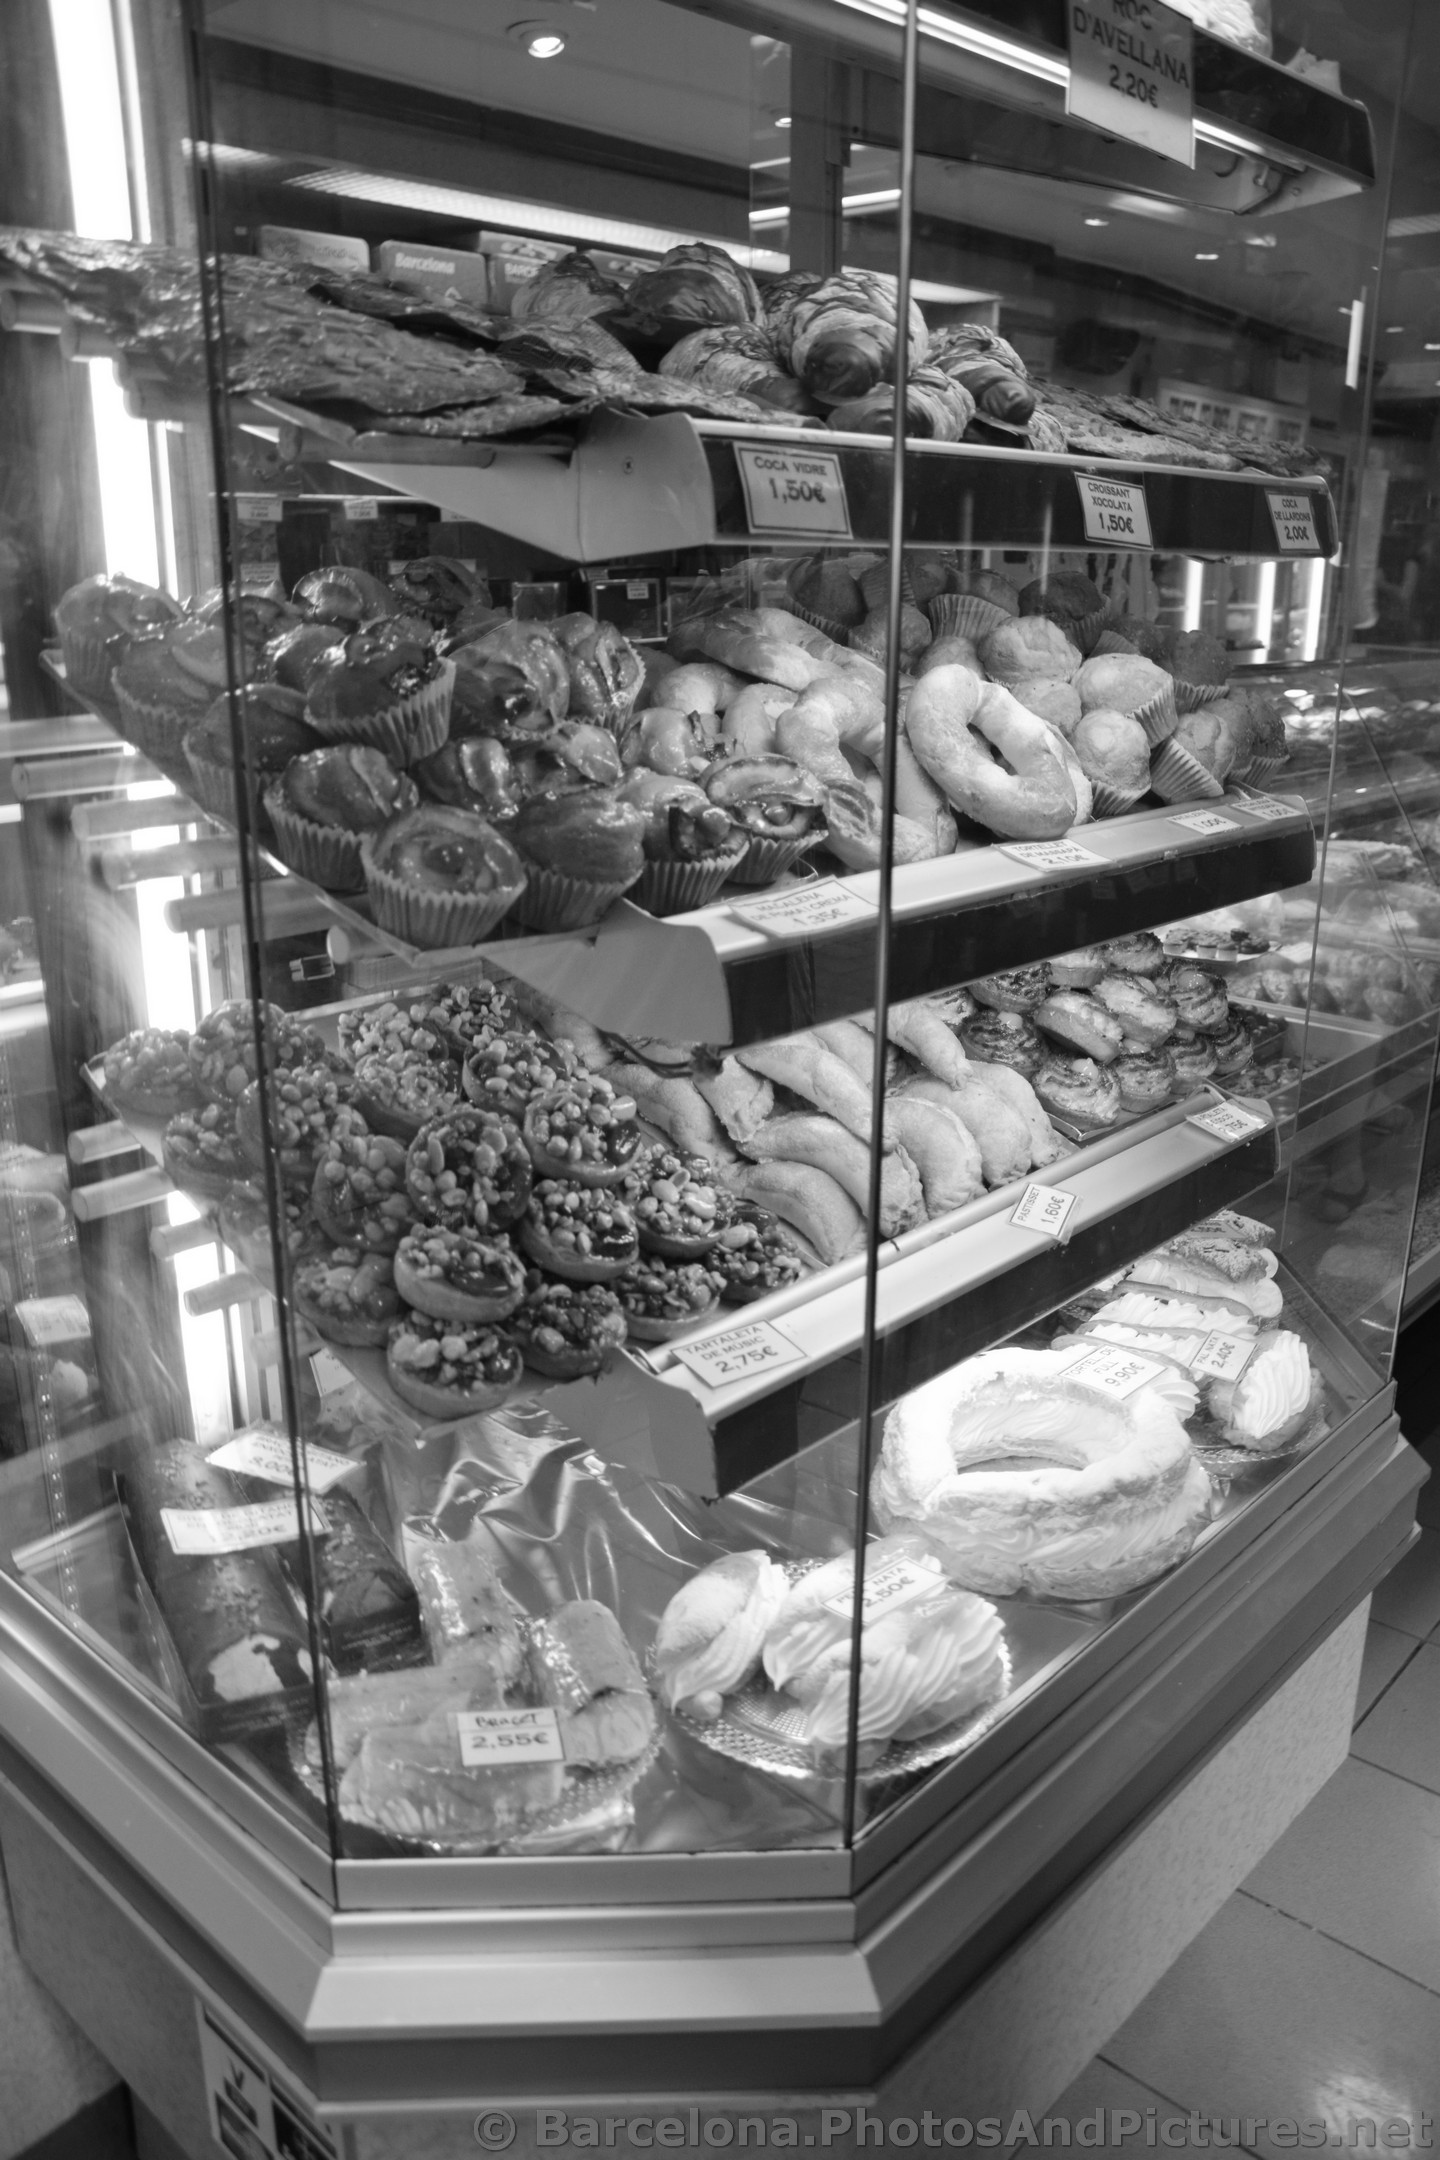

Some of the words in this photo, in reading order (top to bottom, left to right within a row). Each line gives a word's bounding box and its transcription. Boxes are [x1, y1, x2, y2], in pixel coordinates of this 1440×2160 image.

[1073, 5, 1189, 89] D'AVELLANA
[394, 252, 456, 275] Barcelona
[753, 456, 790, 472] COCA
[792, 462, 828, 476] VIDRE
[768, 477, 827, 503] 1,50€
[1087, 482, 1131, 498] CROISSANT
[1091, 496, 1134, 512] XOCOLATA
[1098, 512, 1135, 534] 1,50€
[1284, 525, 1310, 543] 2,00€
[810, 893, 854, 910] CREMA
[1017, 1186, 1041, 1222] PASTISSET
[685, 1325, 763, 1355] TARTALETA
[700, 1349, 719, 1361] DE
[715, 1345, 779, 1373] 2,75€
[872, 1567, 907, 1585] NATA
